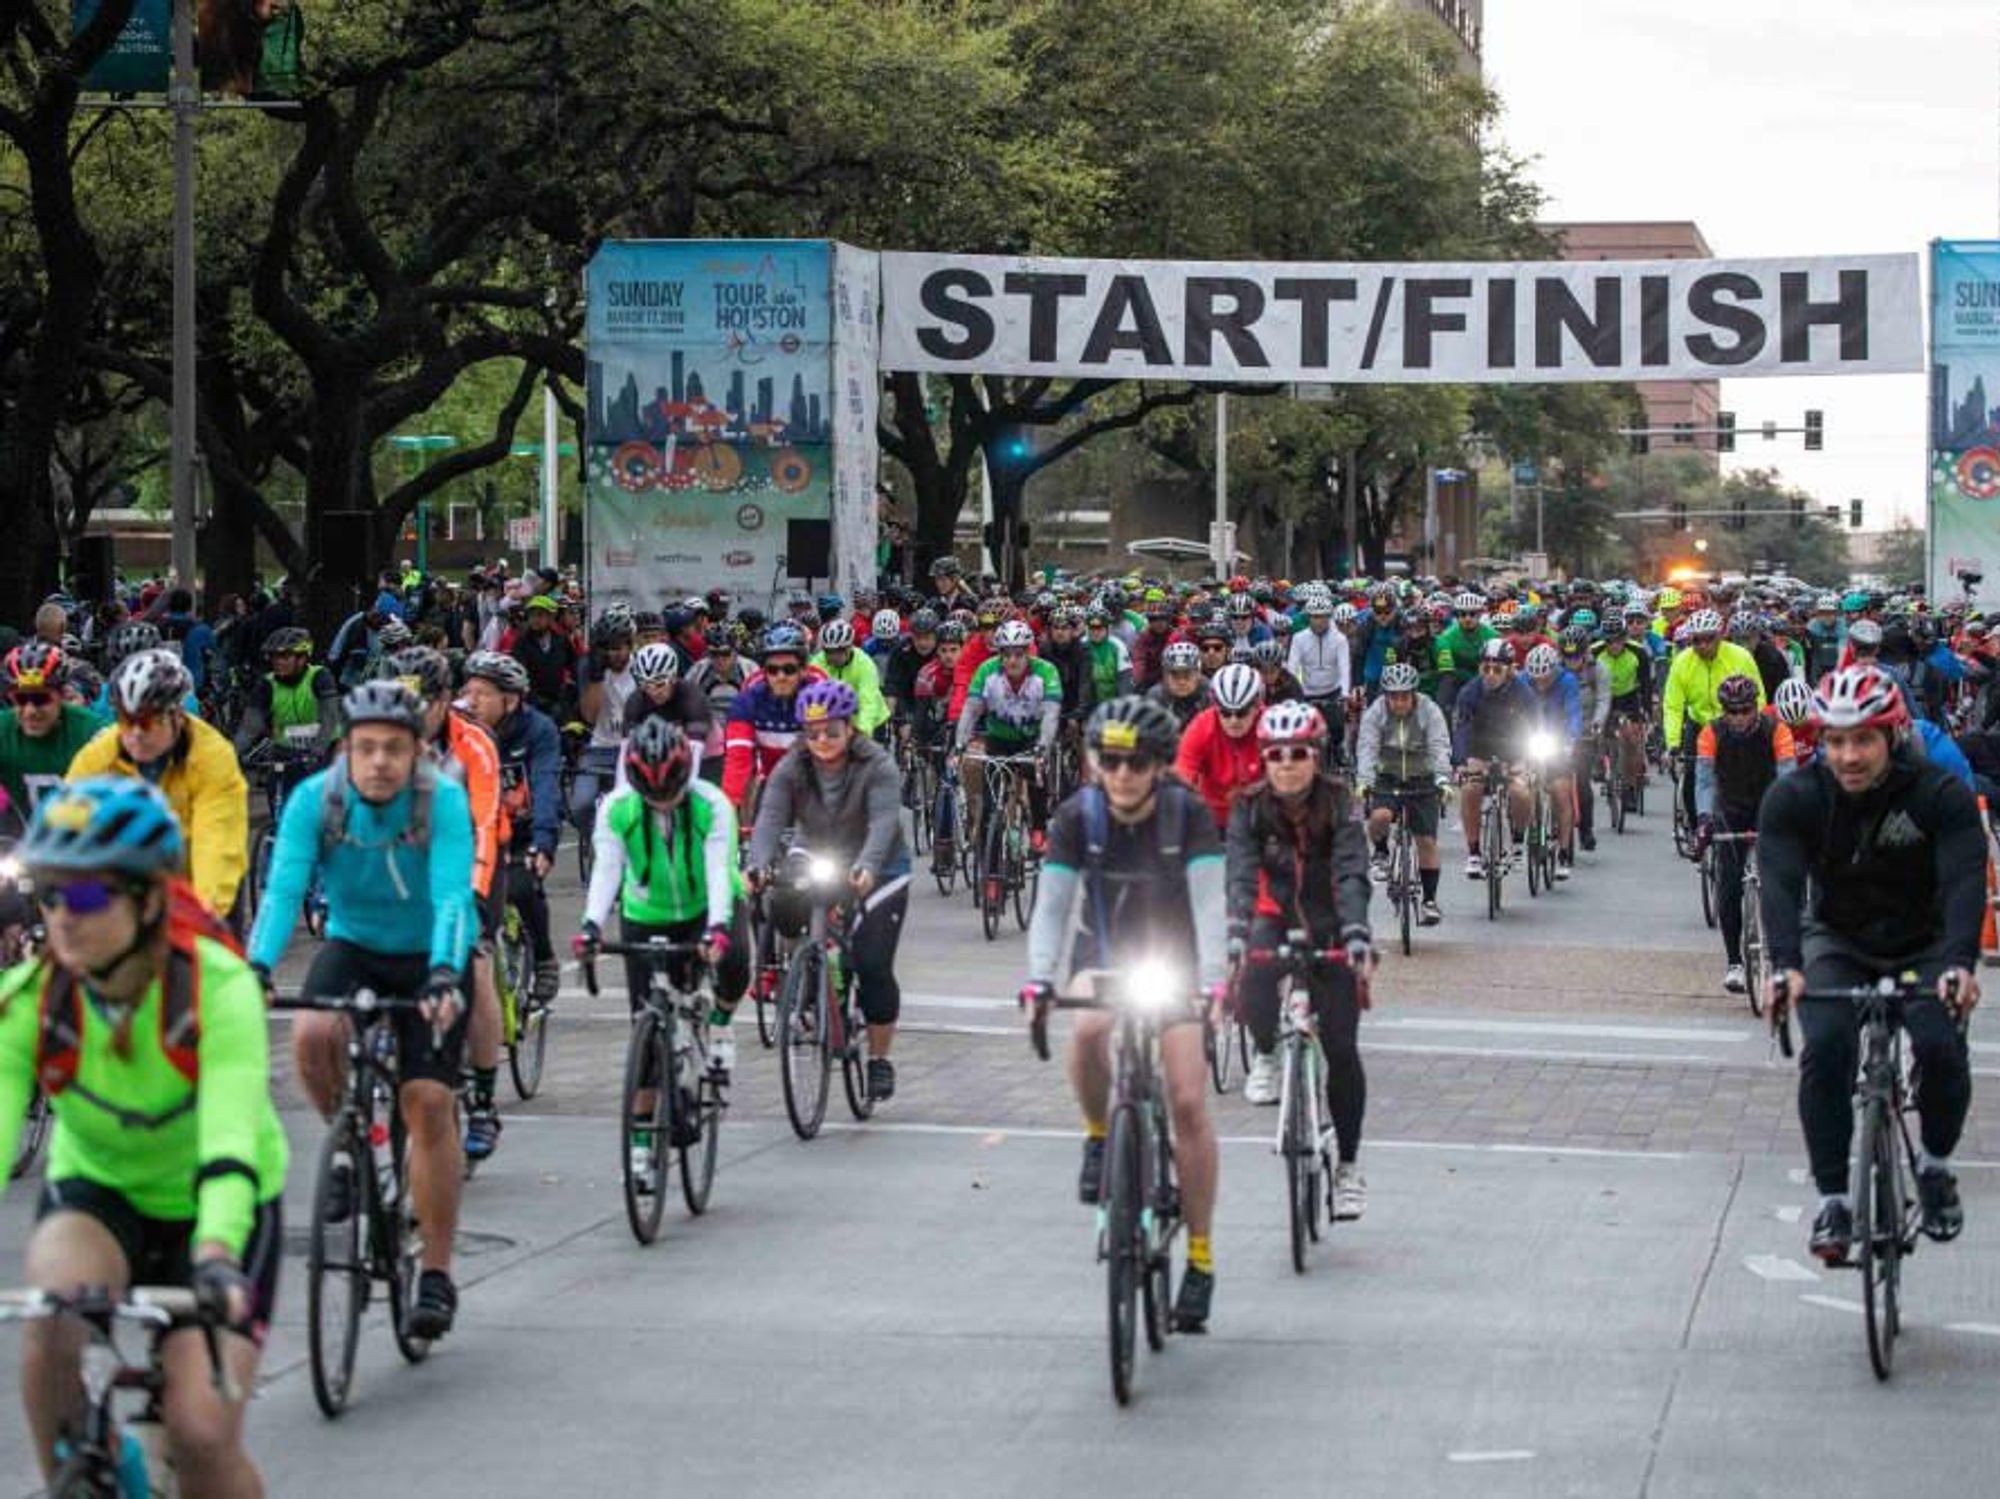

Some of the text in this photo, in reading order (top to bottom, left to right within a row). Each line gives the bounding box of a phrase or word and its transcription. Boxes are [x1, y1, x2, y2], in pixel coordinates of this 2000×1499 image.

[608, 281, 684, 307] SUNDAY
[713, 283, 767, 306] TOUR
[1956, 280, 2000, 307] SUN
[716, 305, 806, 329] HOUSTON
[917, 266, 1869, 368] START/FINISH
